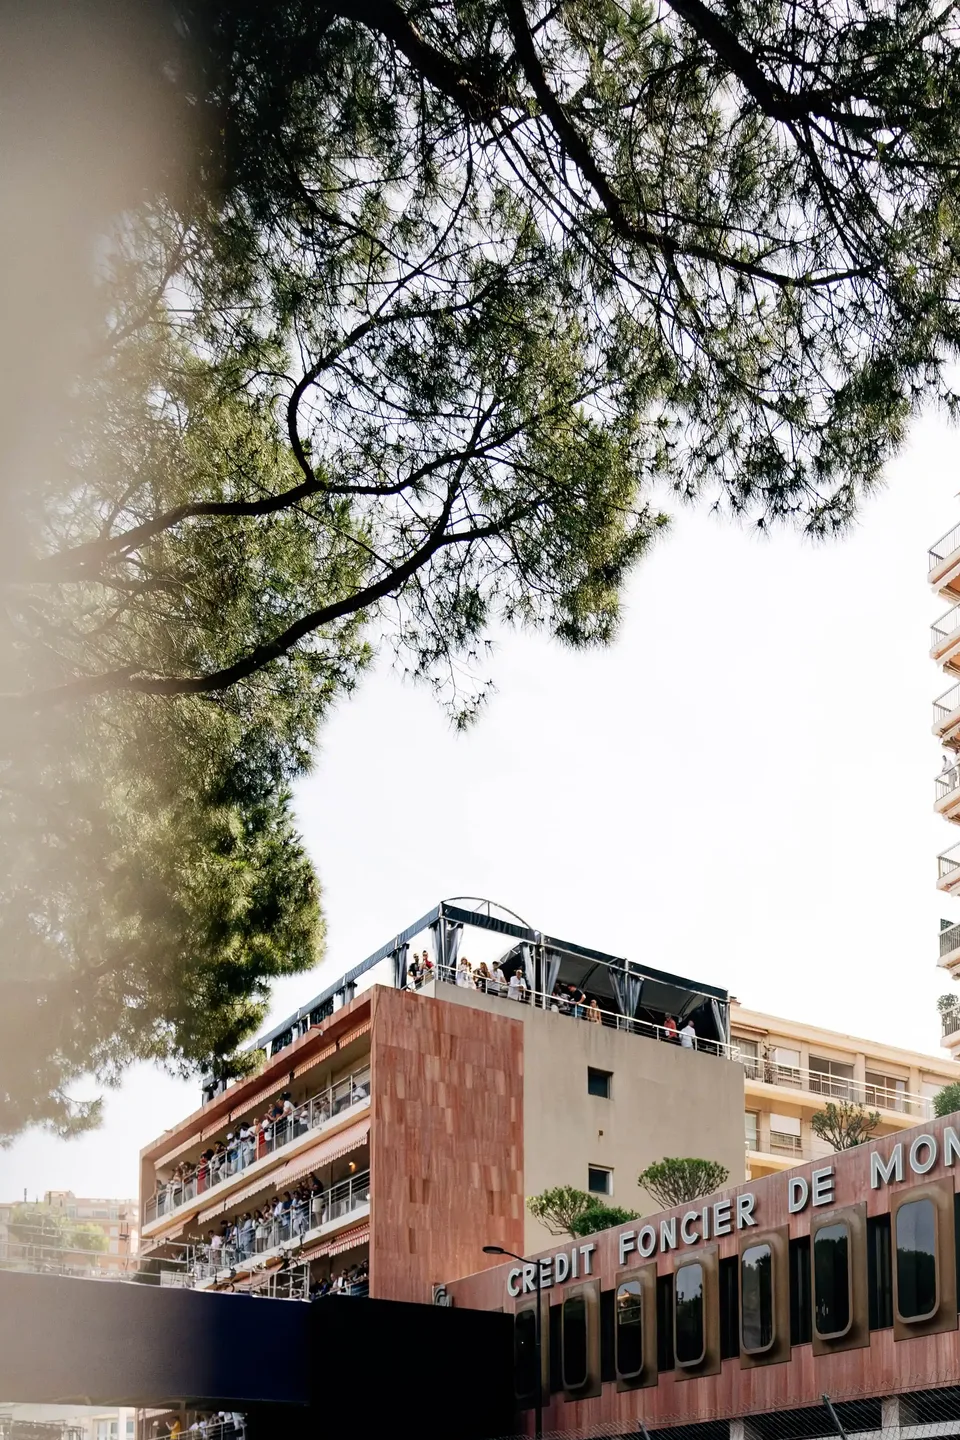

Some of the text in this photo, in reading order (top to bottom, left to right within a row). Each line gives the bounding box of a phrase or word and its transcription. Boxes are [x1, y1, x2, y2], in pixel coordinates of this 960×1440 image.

[507, 1243, 597, 1297] CREDIT
[619, 1192, 758, 1265] FONCIER
[788, 1165, 836, 1214] DE
